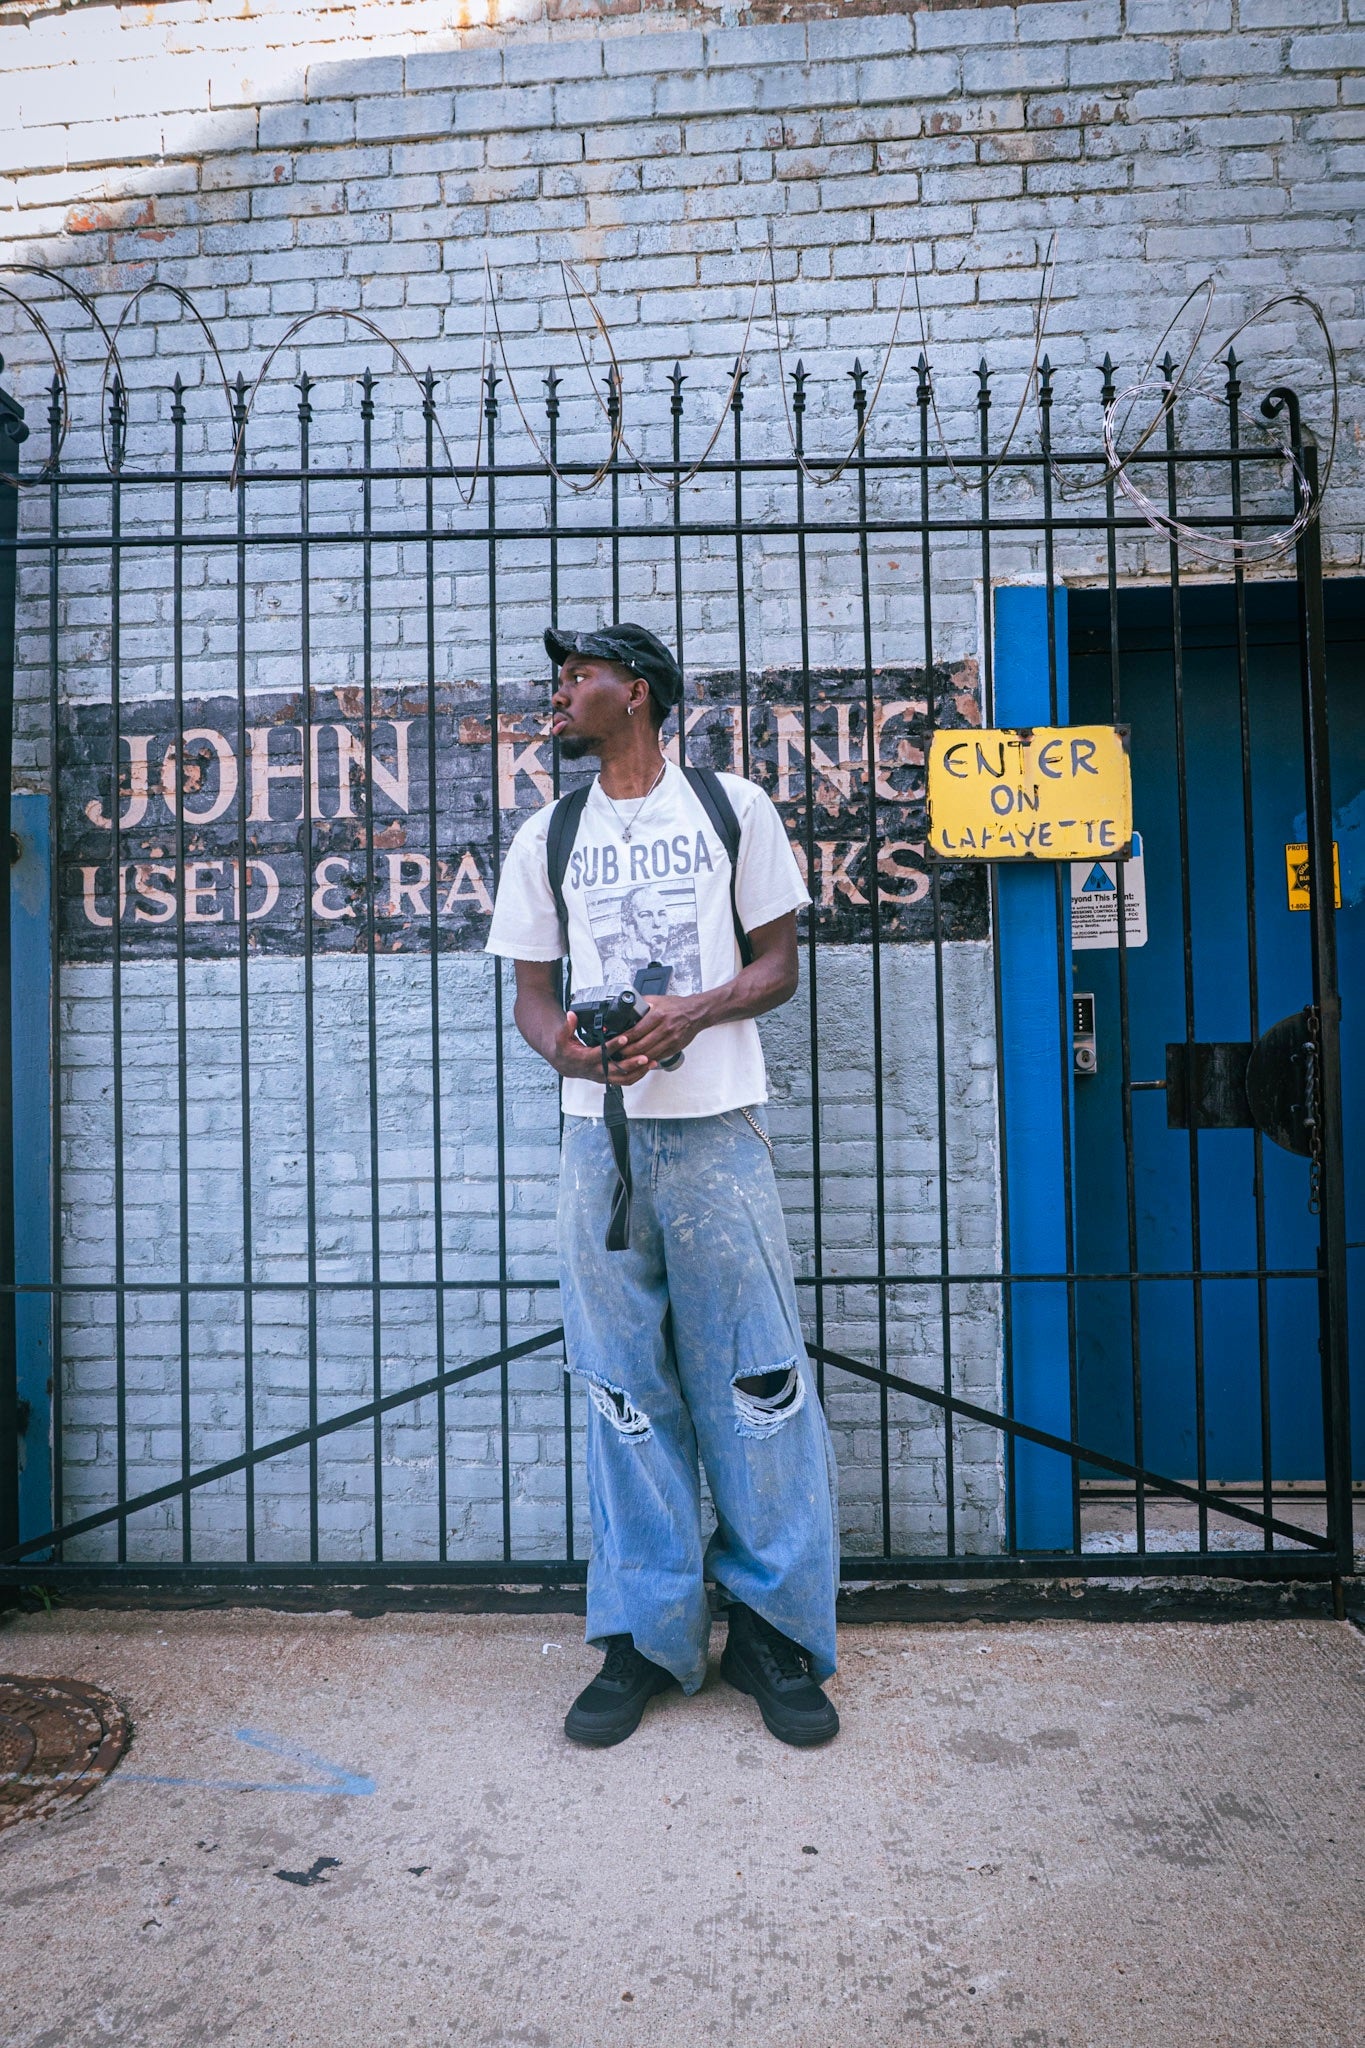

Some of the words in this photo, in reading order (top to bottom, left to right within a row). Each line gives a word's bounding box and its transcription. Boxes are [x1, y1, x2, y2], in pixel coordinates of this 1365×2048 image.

[84, 720, 414, 829] JOHN
[943, 739, 1099, 778] ENTER
[990, 784, 1040, 815] ON
[571, 844, 619, 890] SUB
[630, 830, 714, 881] ROSA
[82, 860, 280, 927] USED
[314, 856, 356, 919] &
[1071, 895, 1092, 904] eyond
[1094, 894, 1110, 902] This
[1112, 893, 1134, 901] Pnt:
